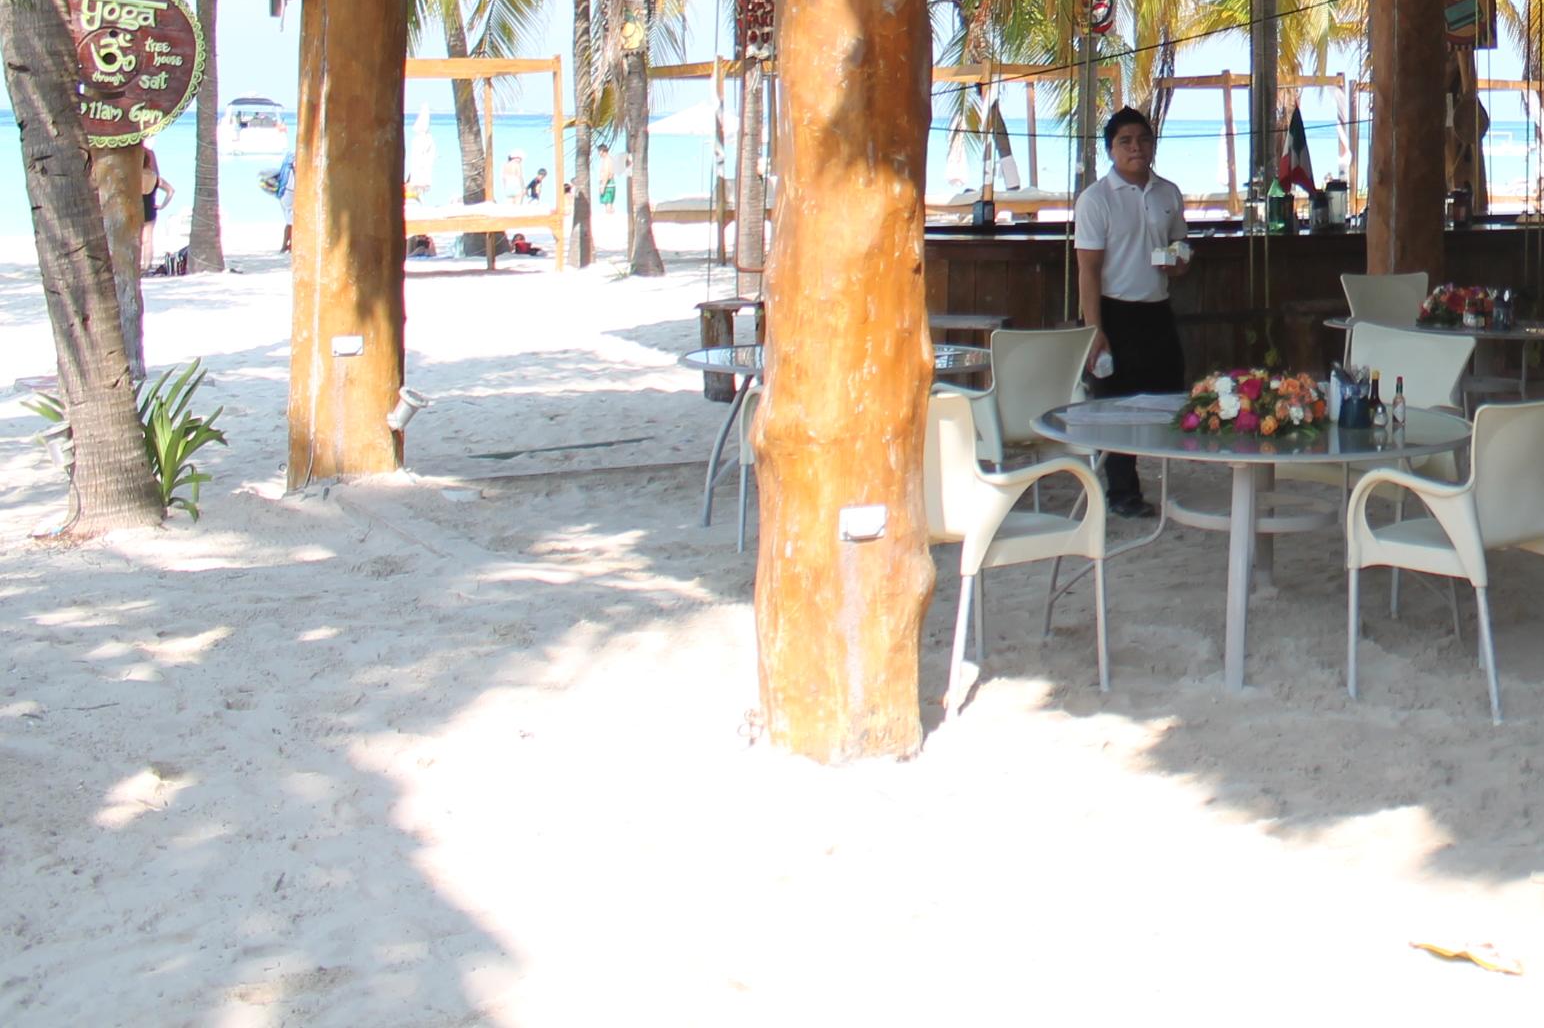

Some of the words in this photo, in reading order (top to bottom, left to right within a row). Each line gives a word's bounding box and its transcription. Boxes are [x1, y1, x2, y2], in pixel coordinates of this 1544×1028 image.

[144, 36, 171, 53] tree
[153, 52, 183, 67] house
[139, 71, 169, 89] sat
[128, 101, 164, 130] 6pm
